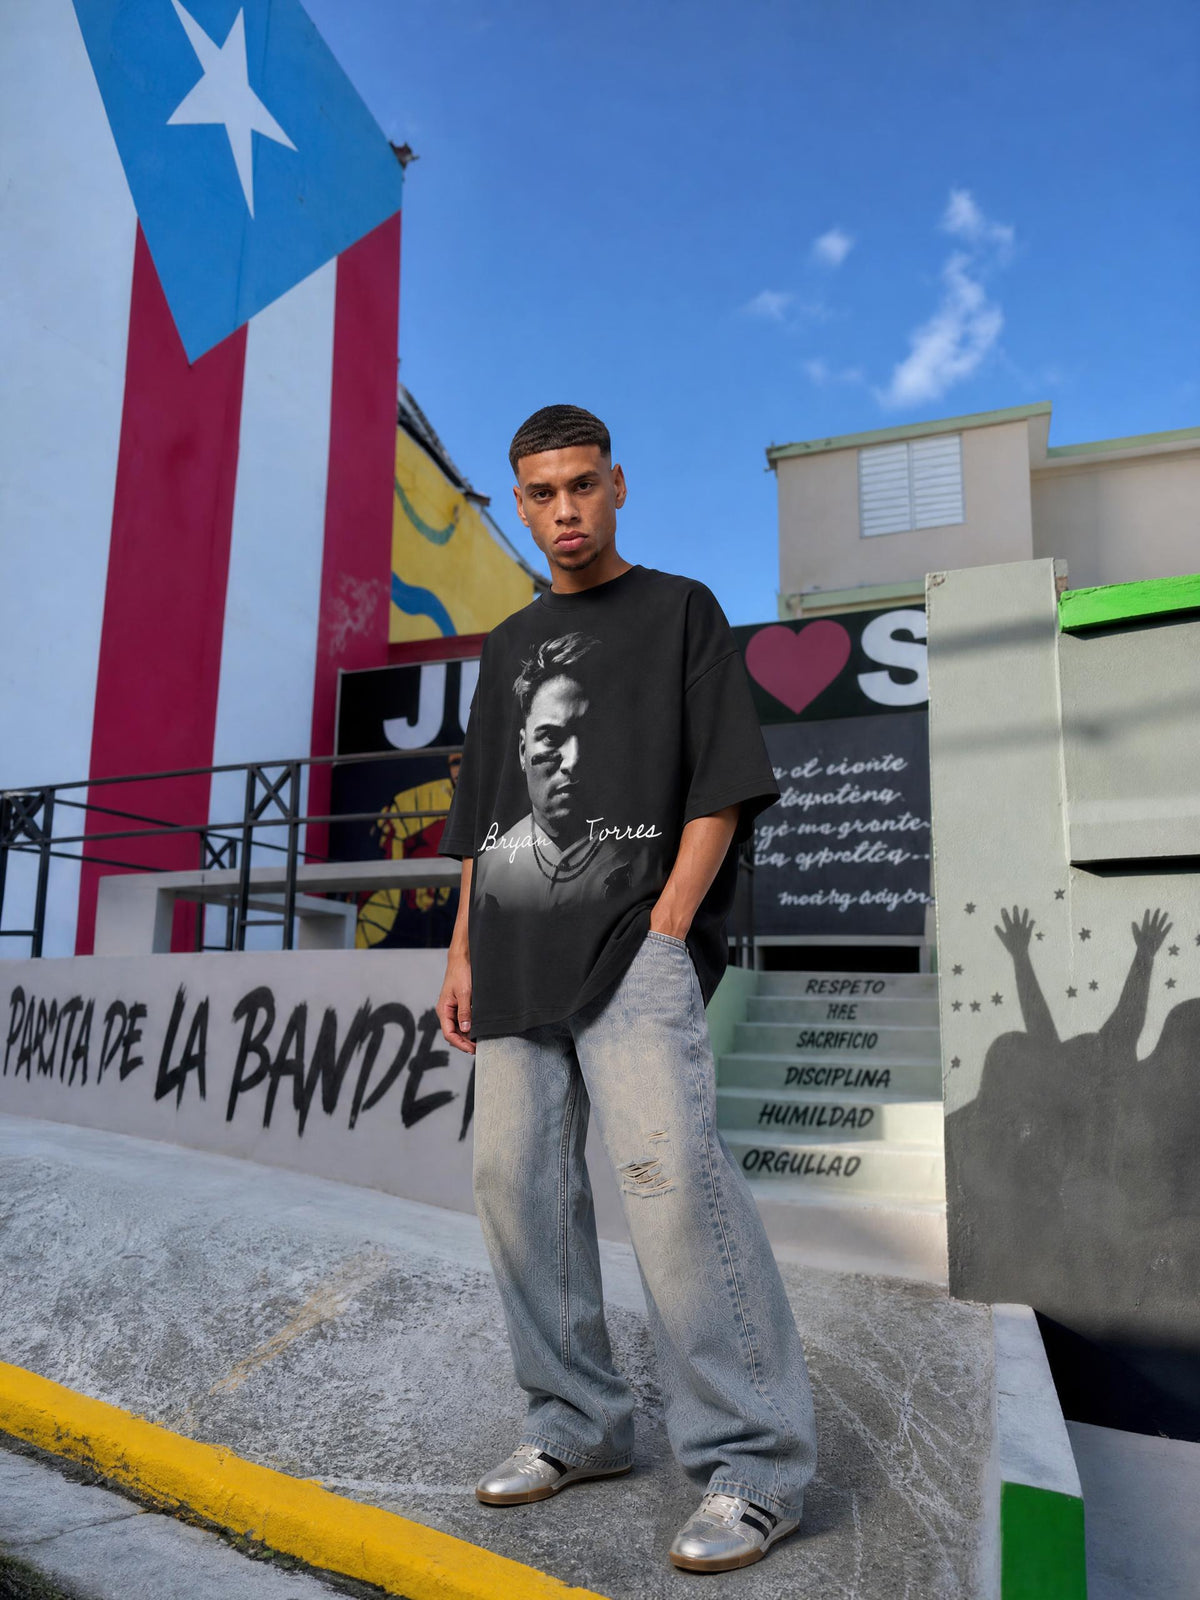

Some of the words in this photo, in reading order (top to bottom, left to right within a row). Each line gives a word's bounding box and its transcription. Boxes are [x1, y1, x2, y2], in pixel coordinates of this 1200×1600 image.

[477, 821, 554, 864] Bryan
[585, 816, 663, 842] Torres
[805, 979, 886, 995] RESPETO
[796, 1031, 879, 1050] SACRIFICIO
[97, 999, 147, 1085] DE
[154, 982, 209, 1111] LA
[226, 986, 475, 1142] BANDE
[784, 1066, 891, 1088] DISCIPLINA
[758, 1103, 875, 1129] HUMILDAD
